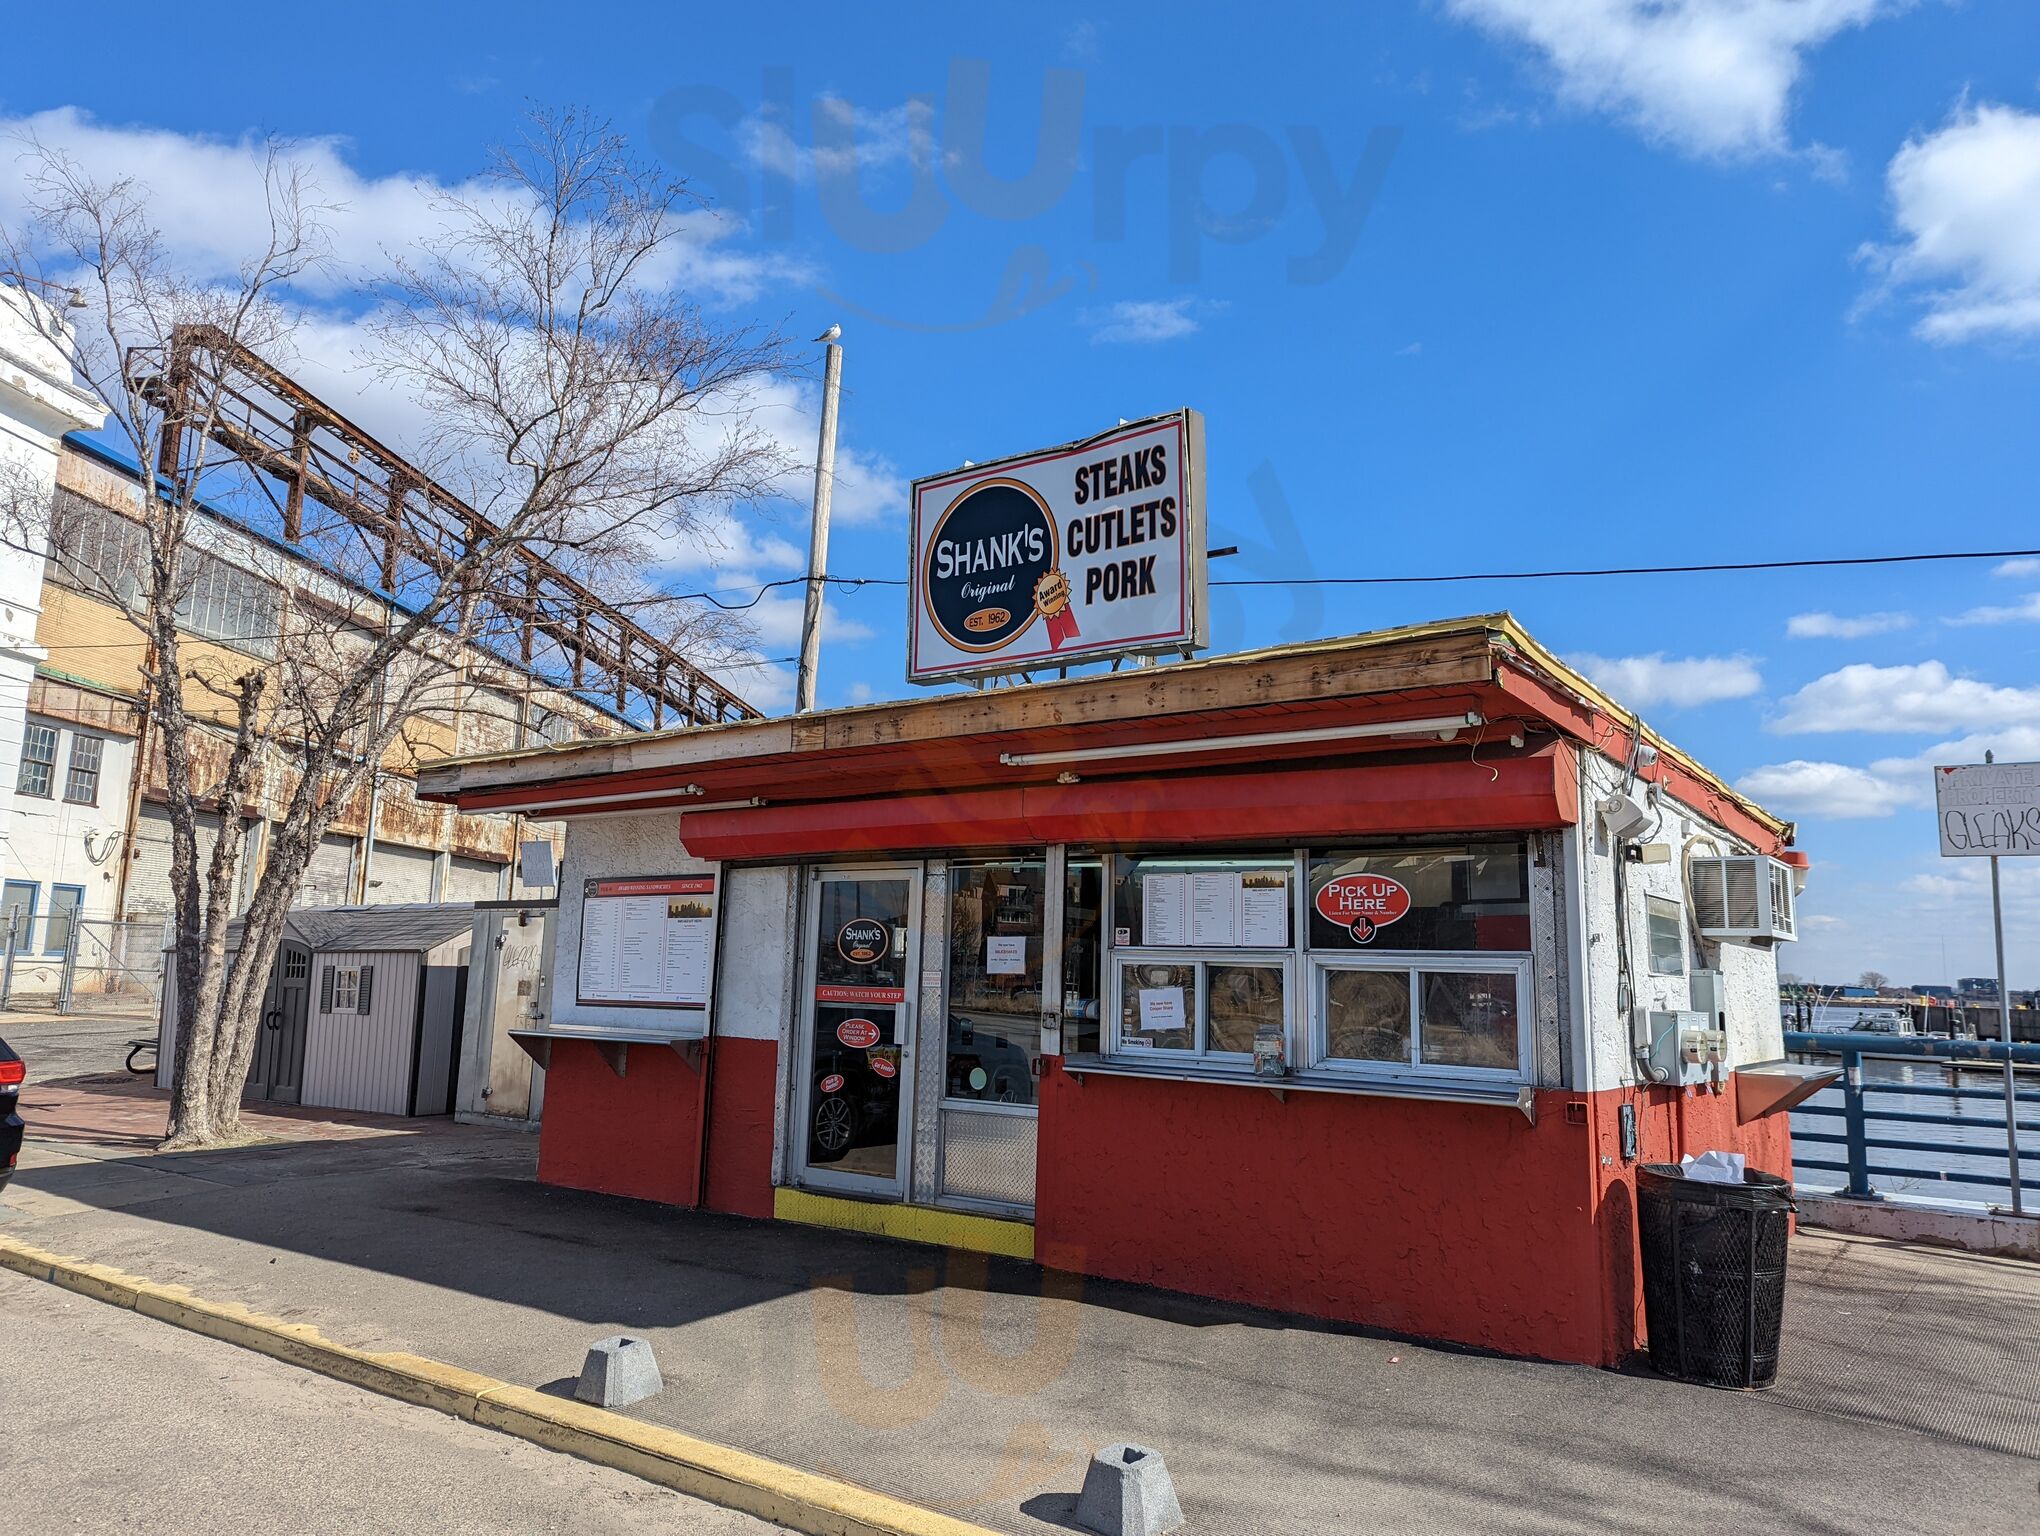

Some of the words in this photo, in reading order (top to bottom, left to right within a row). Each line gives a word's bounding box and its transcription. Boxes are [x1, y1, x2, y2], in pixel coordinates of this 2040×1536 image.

[1074, 444, 1167, 505] STEAKS
[1066, 496, 1177, 558] CUTLETS
[936, 523, 1044, 579] SHANK'S
[961, 574, 1016, 603] Original
[1085, 554, 1157, 606] PORK
[1038, 579, 1063, 602] Award
[1042, 590, 1065, 608] Winning
[969, 616, 984, 628] EST.
[988, 611, 1006, 625] 1962
[1328, 884, 1368, 897] PICK
[1372, 883, 1398, 897] UP
[1339, 897, 1387, 910] HERE
[845, 927, 881, 940] SHANK'S
[850, 990, 870, 998] WATCH
[870, 991, 887, 999] YOUR
[887, 991, 902, 999] STEP
[841, 1028, 861, 1036] ORDER
[845, 1022, 865, 1030] PLEASE
[1128, 1039, 1145, 1047] Smoking
